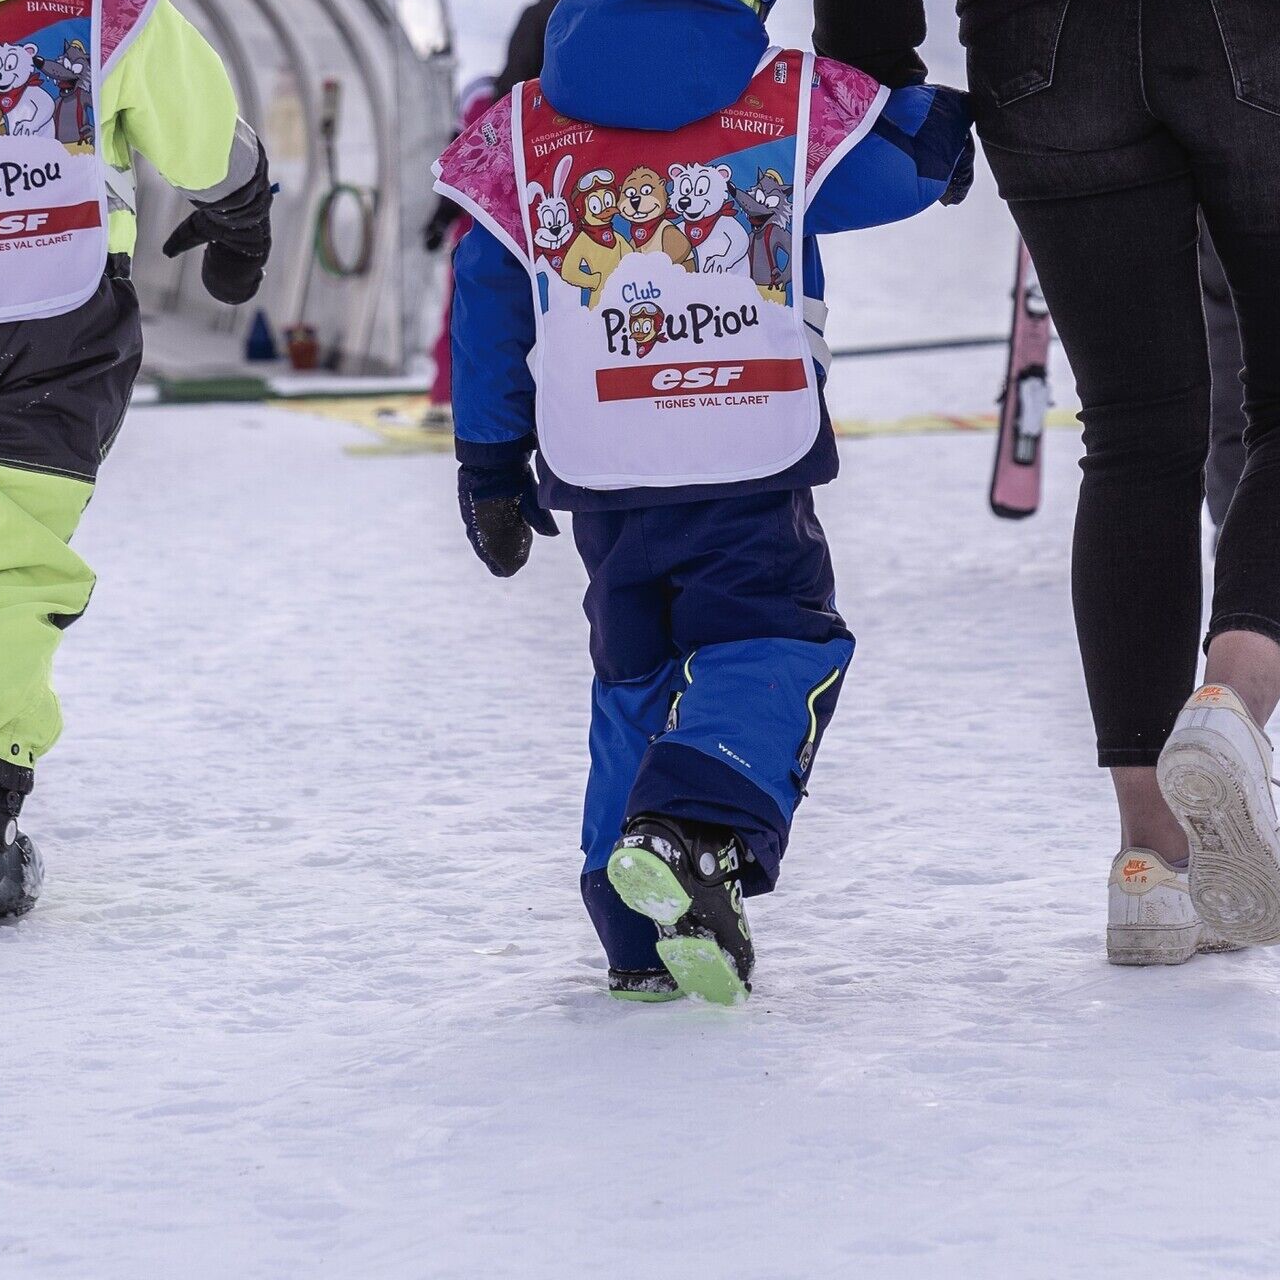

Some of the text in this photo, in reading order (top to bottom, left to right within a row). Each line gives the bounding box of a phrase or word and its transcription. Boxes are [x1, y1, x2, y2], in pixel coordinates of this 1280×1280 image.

[26, 1, 85, 17] BIARRITZ
[719, 108, 774, 122] LABORATOIRES
[720, 116, 785, 137] BIARRITZ
[532, 129, 595, 157] BIARRITZ
[14, 241, 33, 250] VAL
[35, 233, 73, 248] CLARET
[621, 280, 661, 303] Club
[654, 395, 770, 410] TIGNES VAL CLARET
[1126, 859, 1148, 870] NIKE
[1124, 875, 1148, 883] AIR
